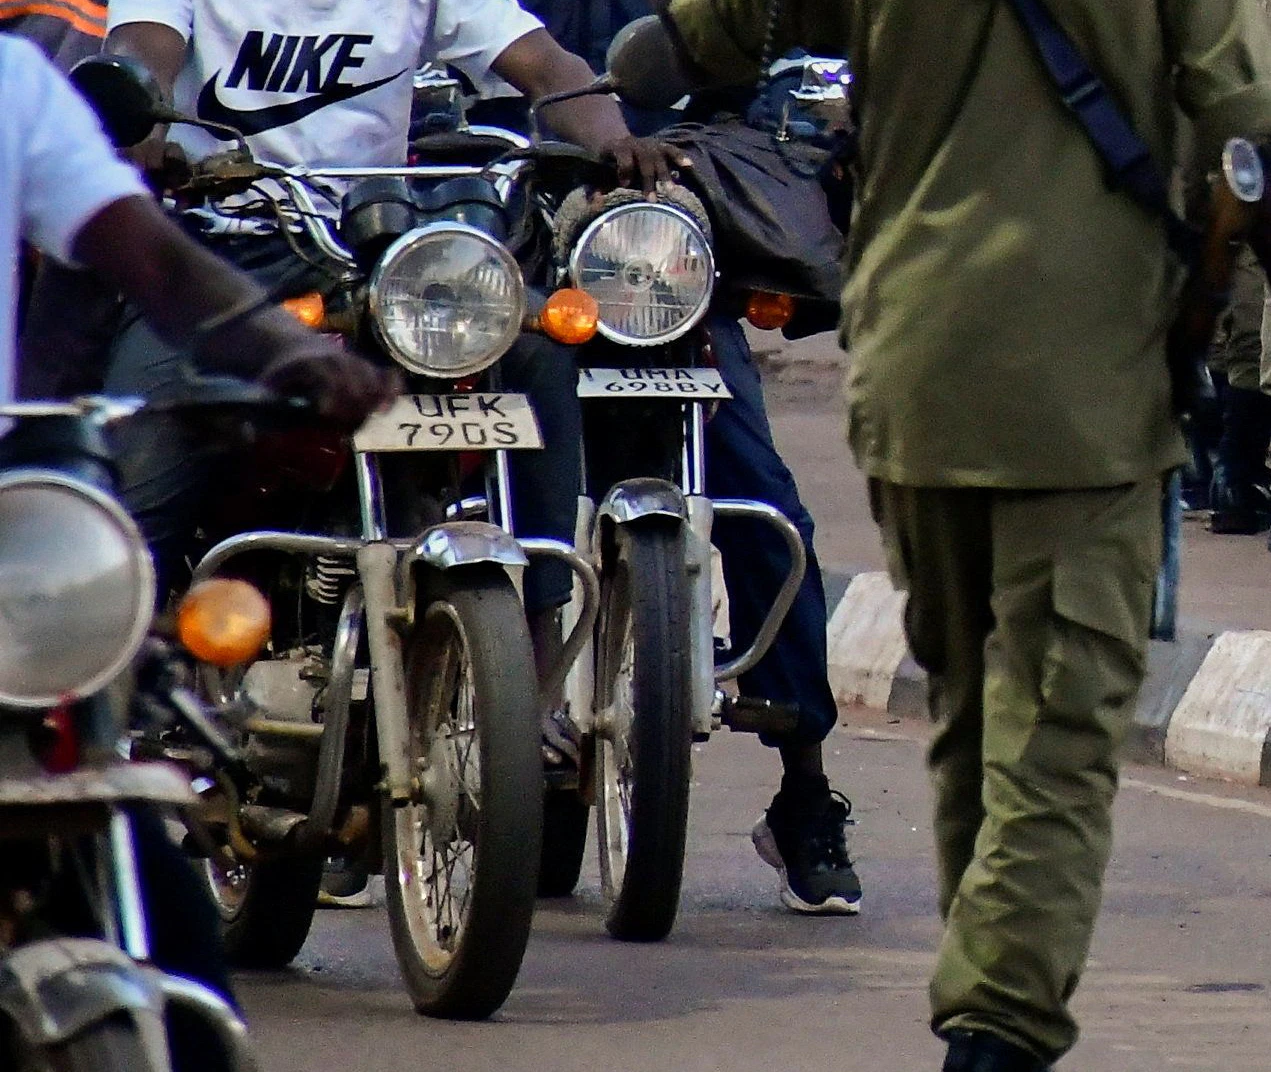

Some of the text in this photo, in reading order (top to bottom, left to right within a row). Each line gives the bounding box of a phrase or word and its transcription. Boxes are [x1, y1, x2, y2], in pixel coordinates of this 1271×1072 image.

[224, 31, 374, 94] NIKE
[605, 380, 722, 394] 698BY
[412, 394, 507, 418] UFK
